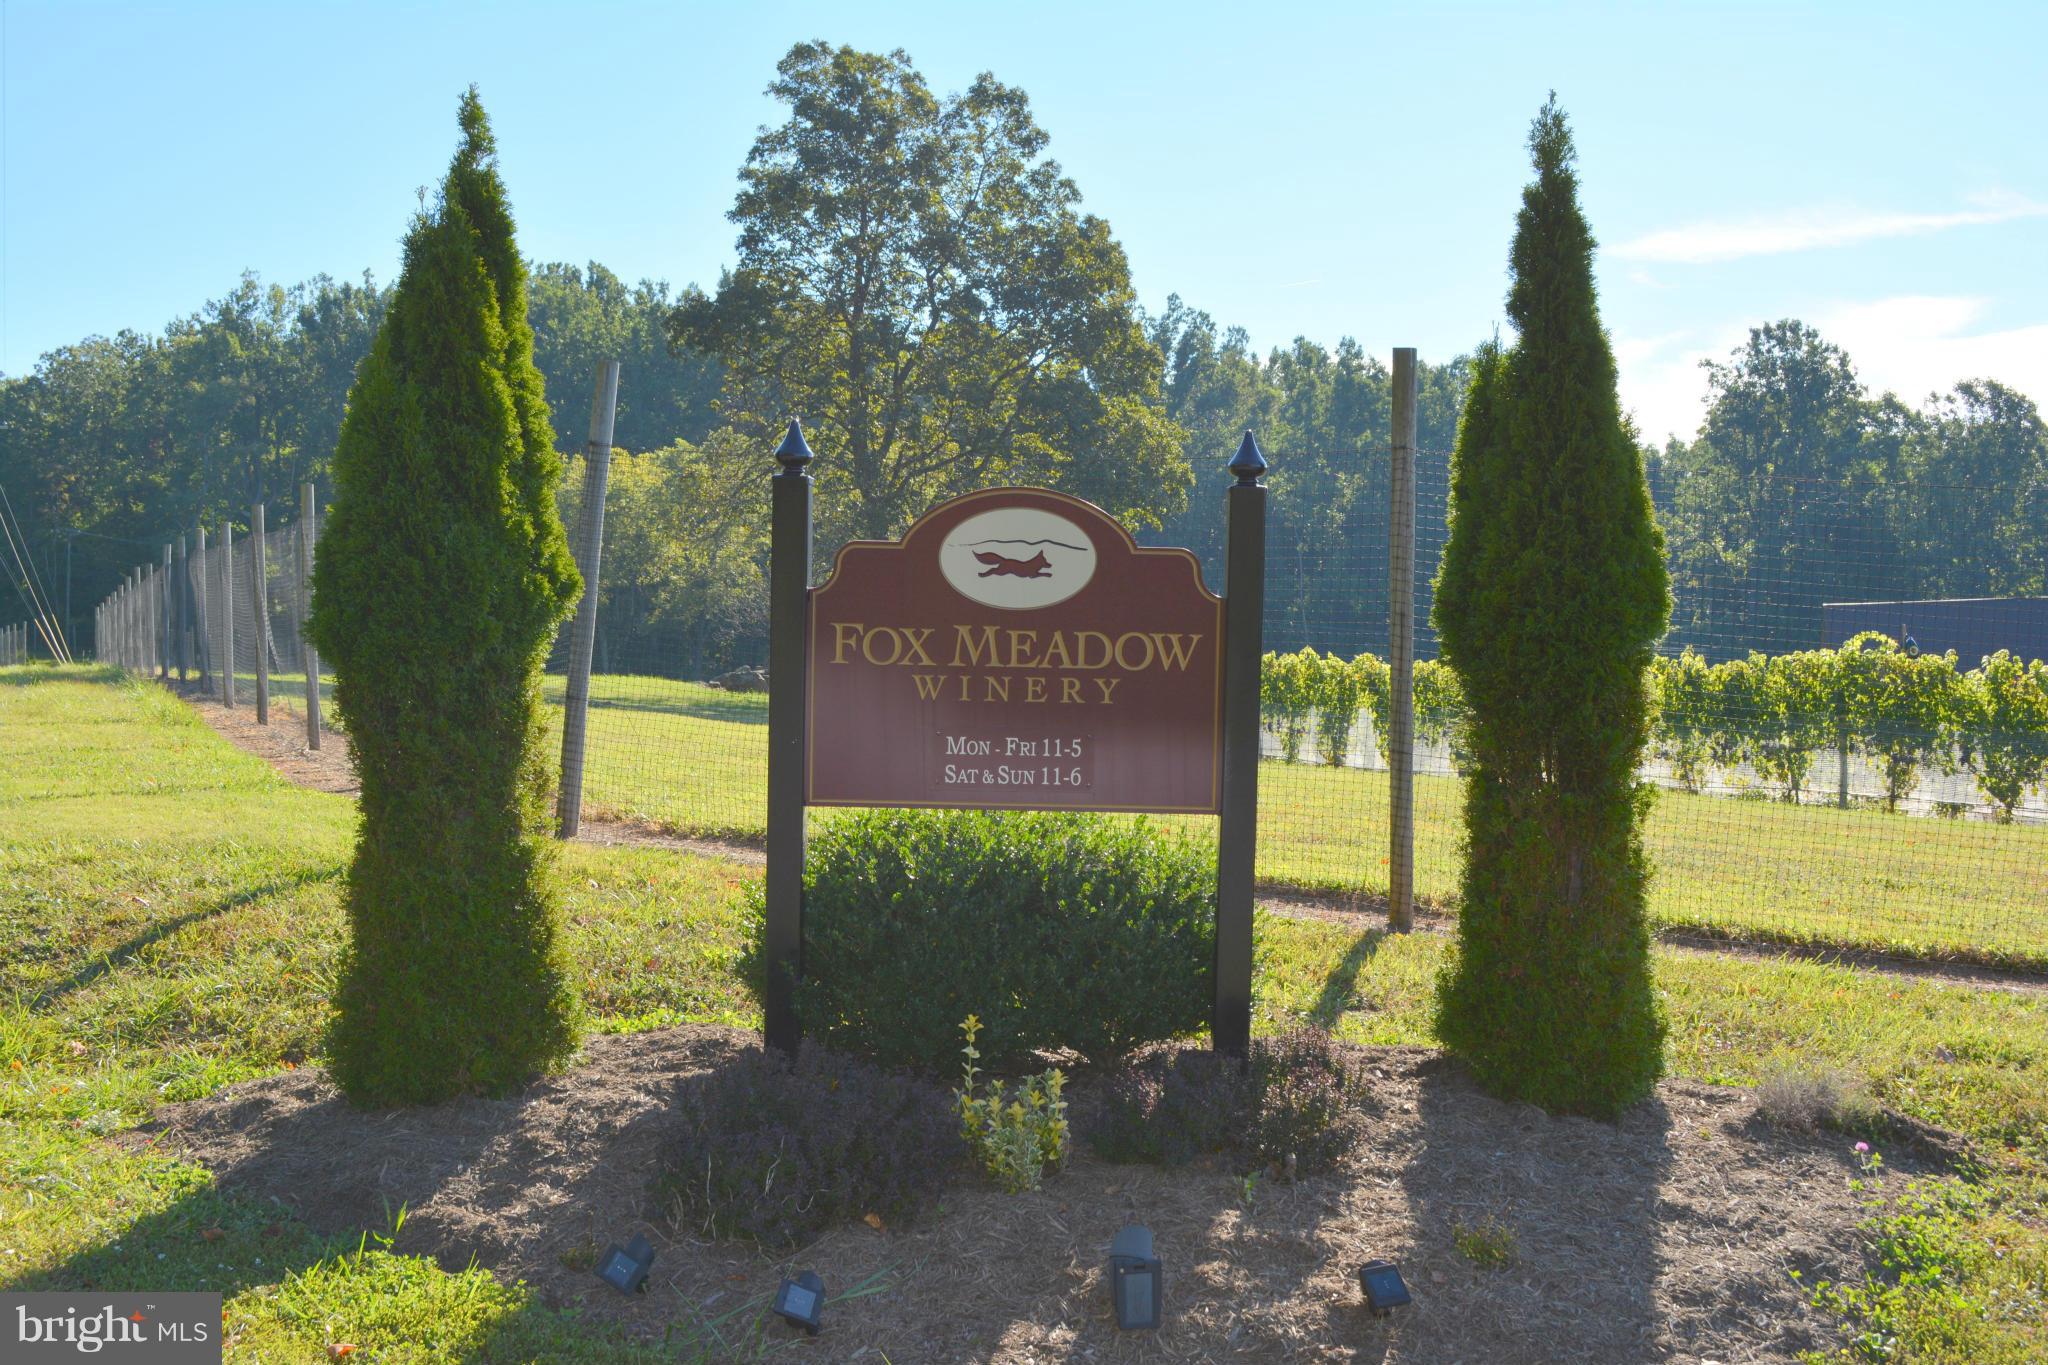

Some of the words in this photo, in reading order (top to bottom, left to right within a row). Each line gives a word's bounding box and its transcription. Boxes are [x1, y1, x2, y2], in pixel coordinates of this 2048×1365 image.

[829, 622, 937, 667] FOX
[947, 624, 1203, 672] MEADOW
[912, 674, 1121, 704] WINERY
[1042, 738, 1082, 758] 11-5
[1041, 766, 1082, 786] 11-6
